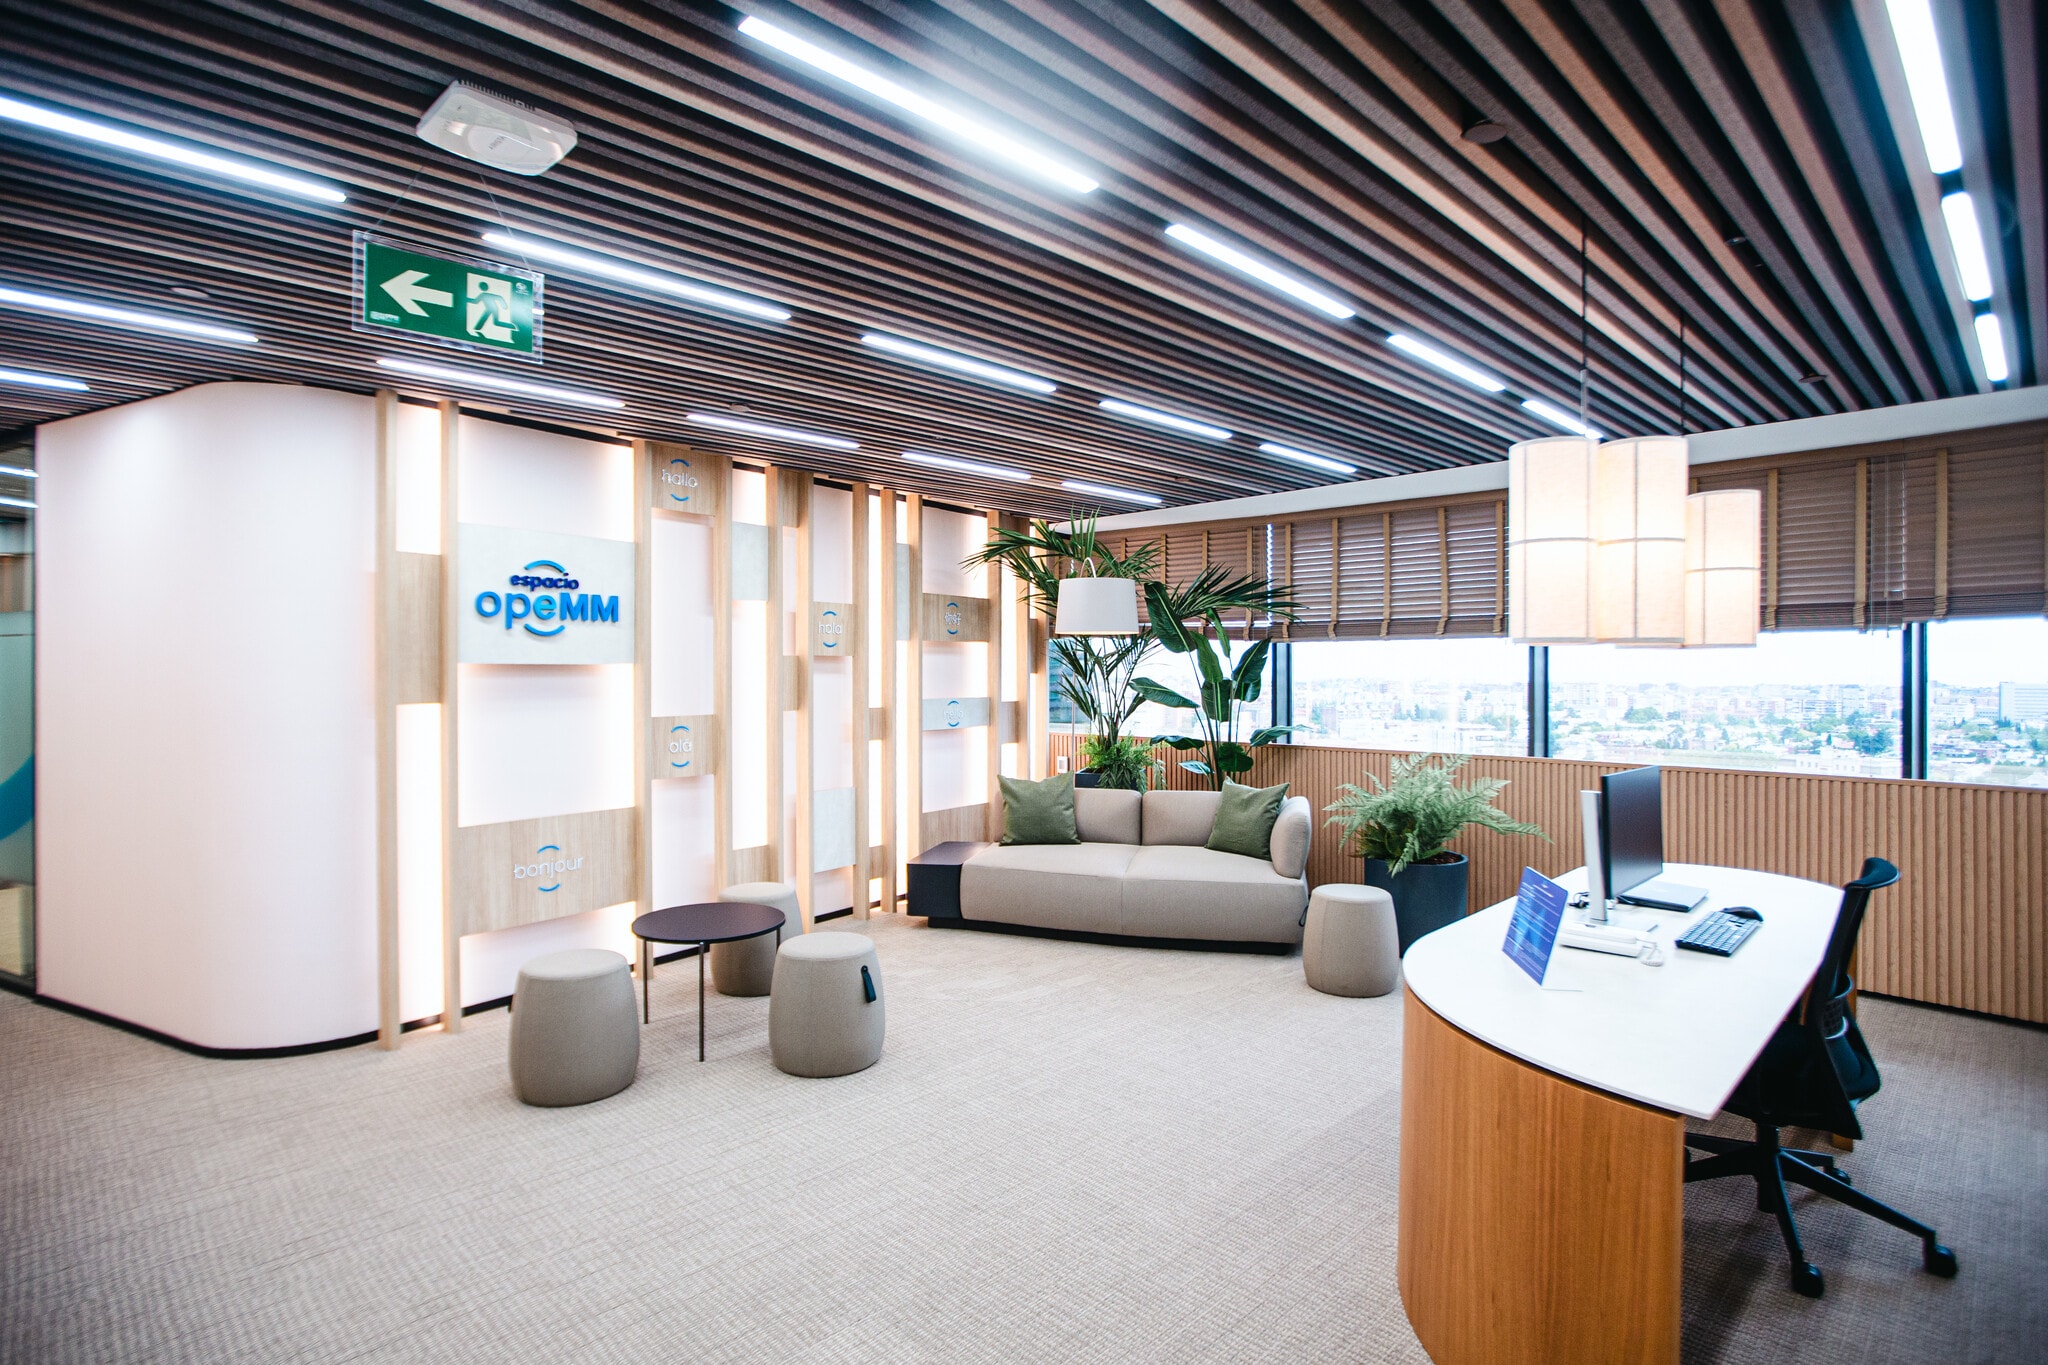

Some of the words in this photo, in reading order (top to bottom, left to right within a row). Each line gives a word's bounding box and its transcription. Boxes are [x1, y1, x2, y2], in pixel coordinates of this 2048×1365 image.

[662, 468, 698, 488] hallo
[509, 572, 579, 592] espacio
[475, 591, 619, 630] opeMM
[818, 621, 842, 635] hola
[513, 857, 584, 879] bonjour
